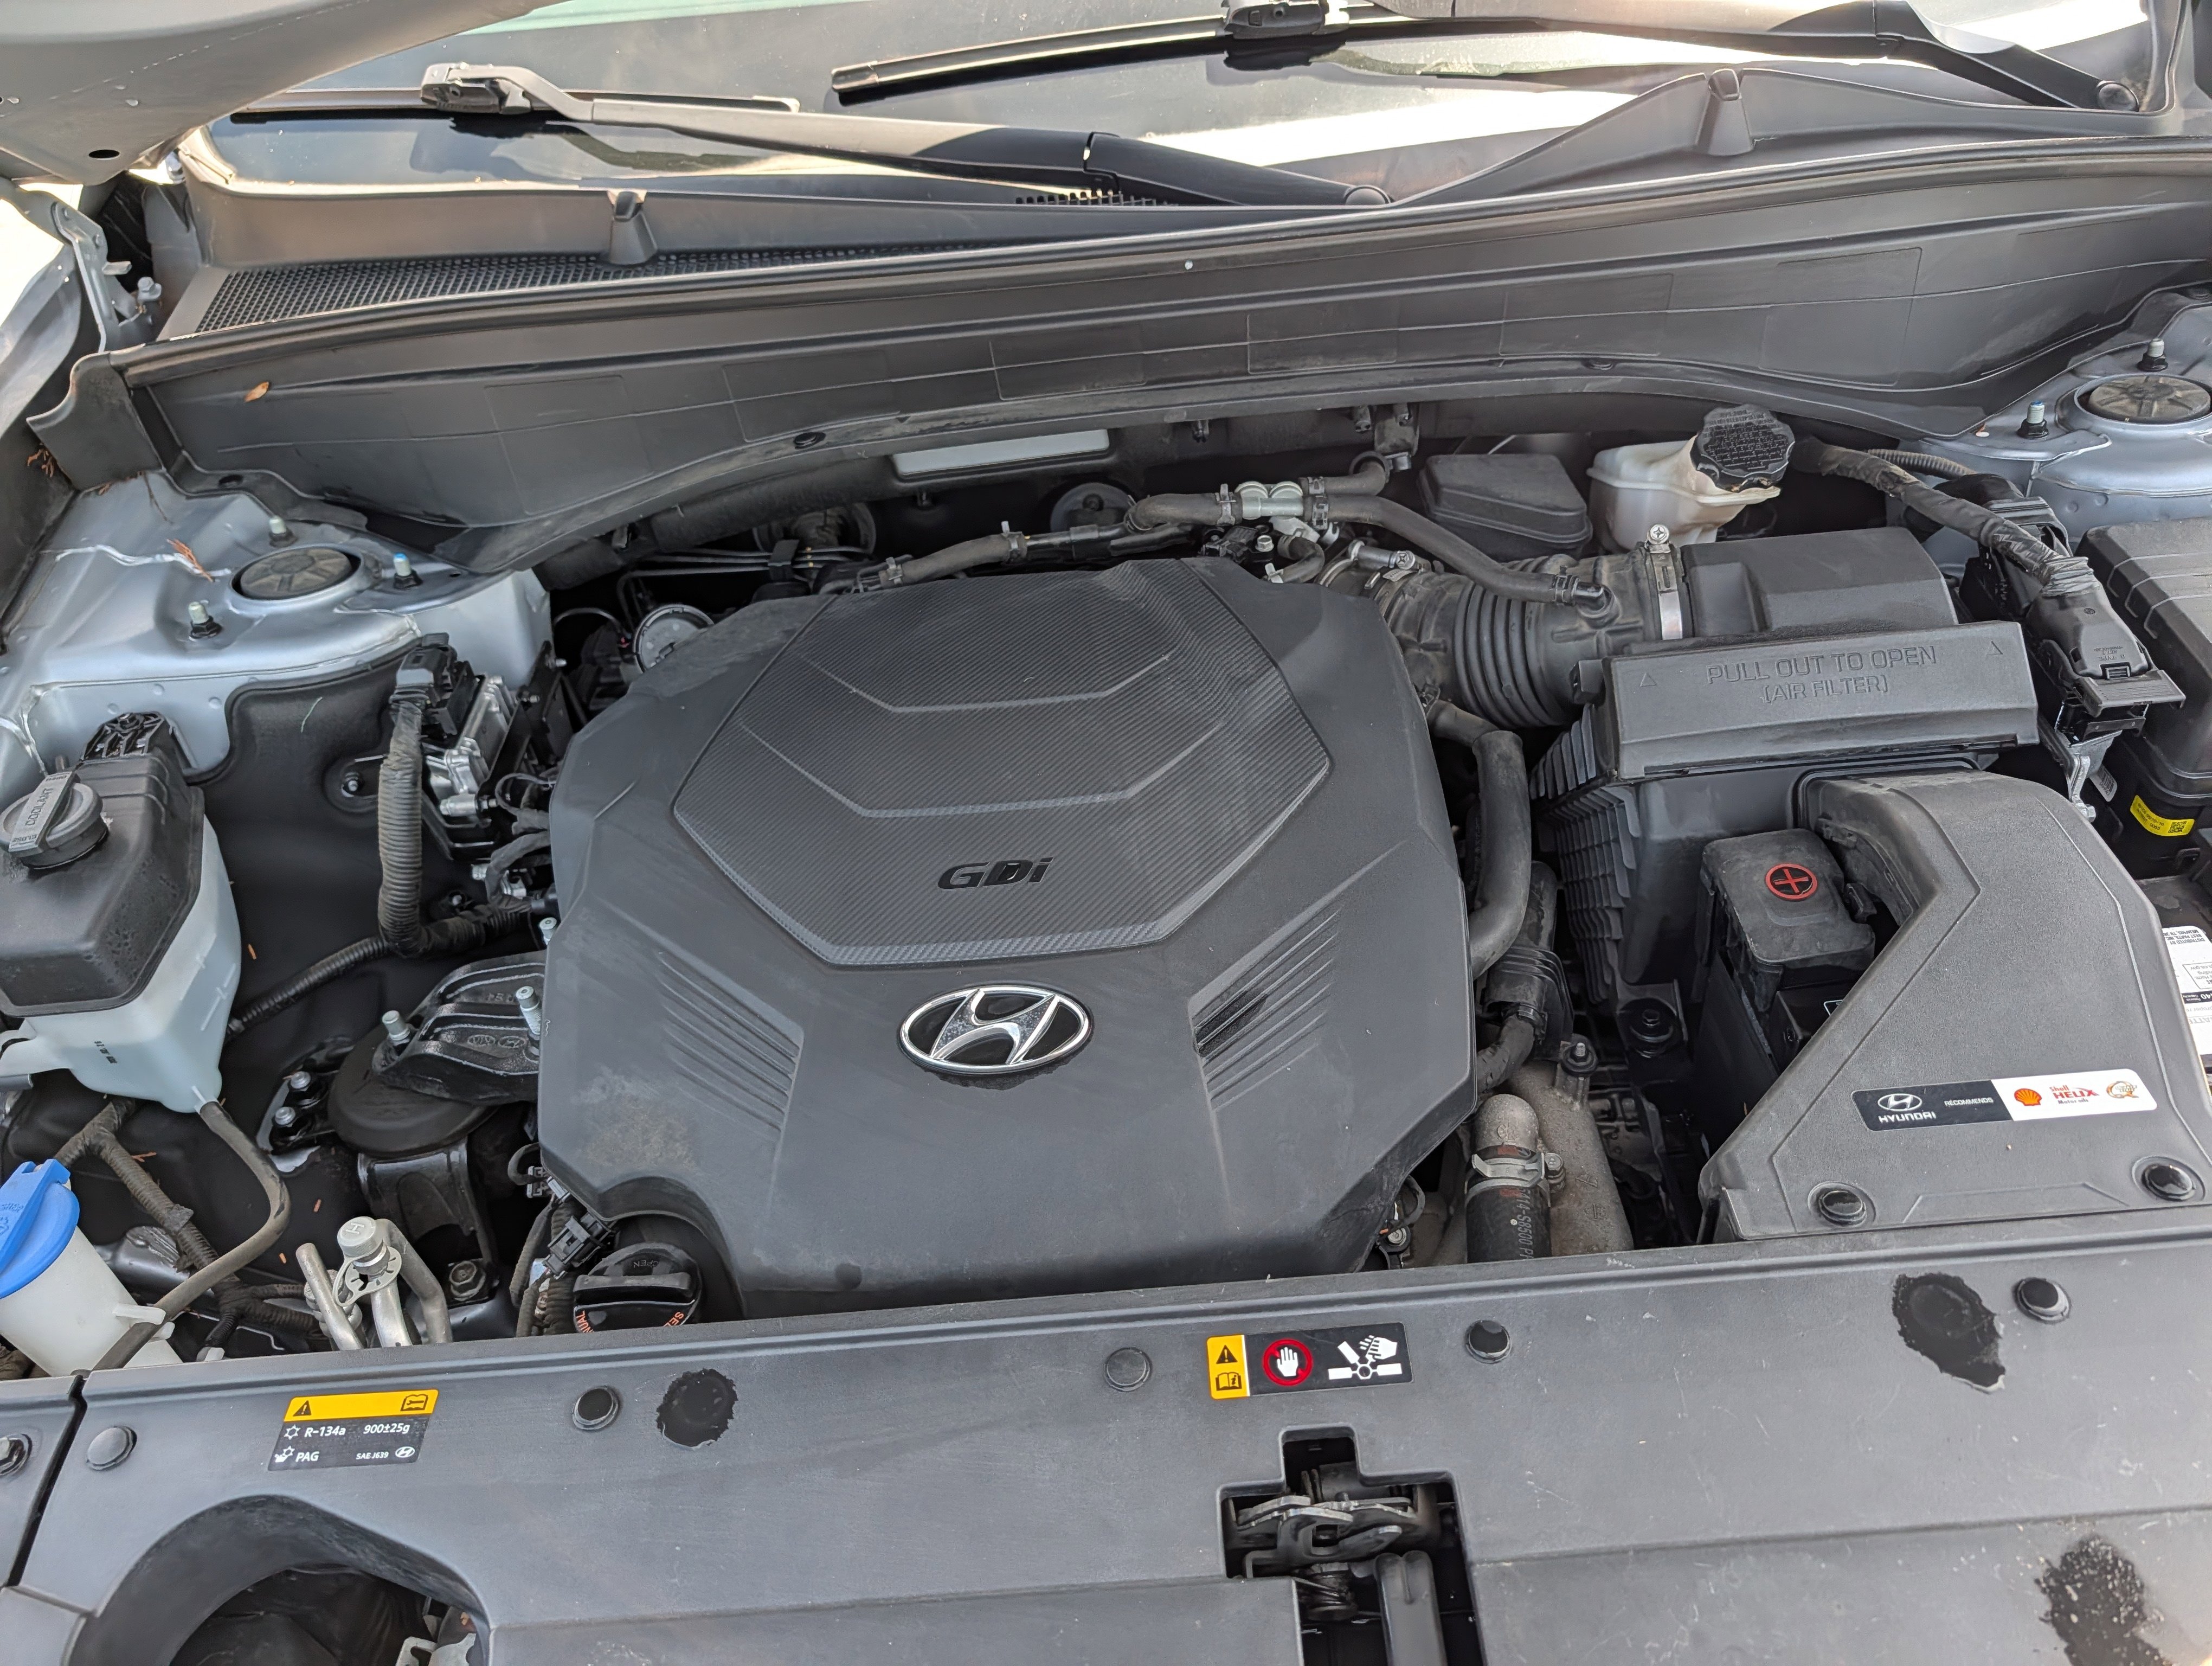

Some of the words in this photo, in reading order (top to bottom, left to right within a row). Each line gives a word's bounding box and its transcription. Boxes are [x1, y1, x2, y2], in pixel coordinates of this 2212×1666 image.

[1706, 661, 1770, 684] PULL
[1774, 655, 1824, 678] OUT
[1830, 651, 1864, 671] TO
[1869, 645, 1937, 669] OPEN
[25, 788, 54, 826] COOLANT
[937, 857, 1053, 889] GDi
[2053, 1088, 2098, 1099] HELIX
[1944, 1098, 1994, 1106] RECOMMENDS
[1878, 1111, 1937, 1123] HYUNDAI
[304, 1425, 347, 1438] R-134a
[363, 1422, 410, 1435] 900±25g
[295, 1451, 320, 1463] PAG
